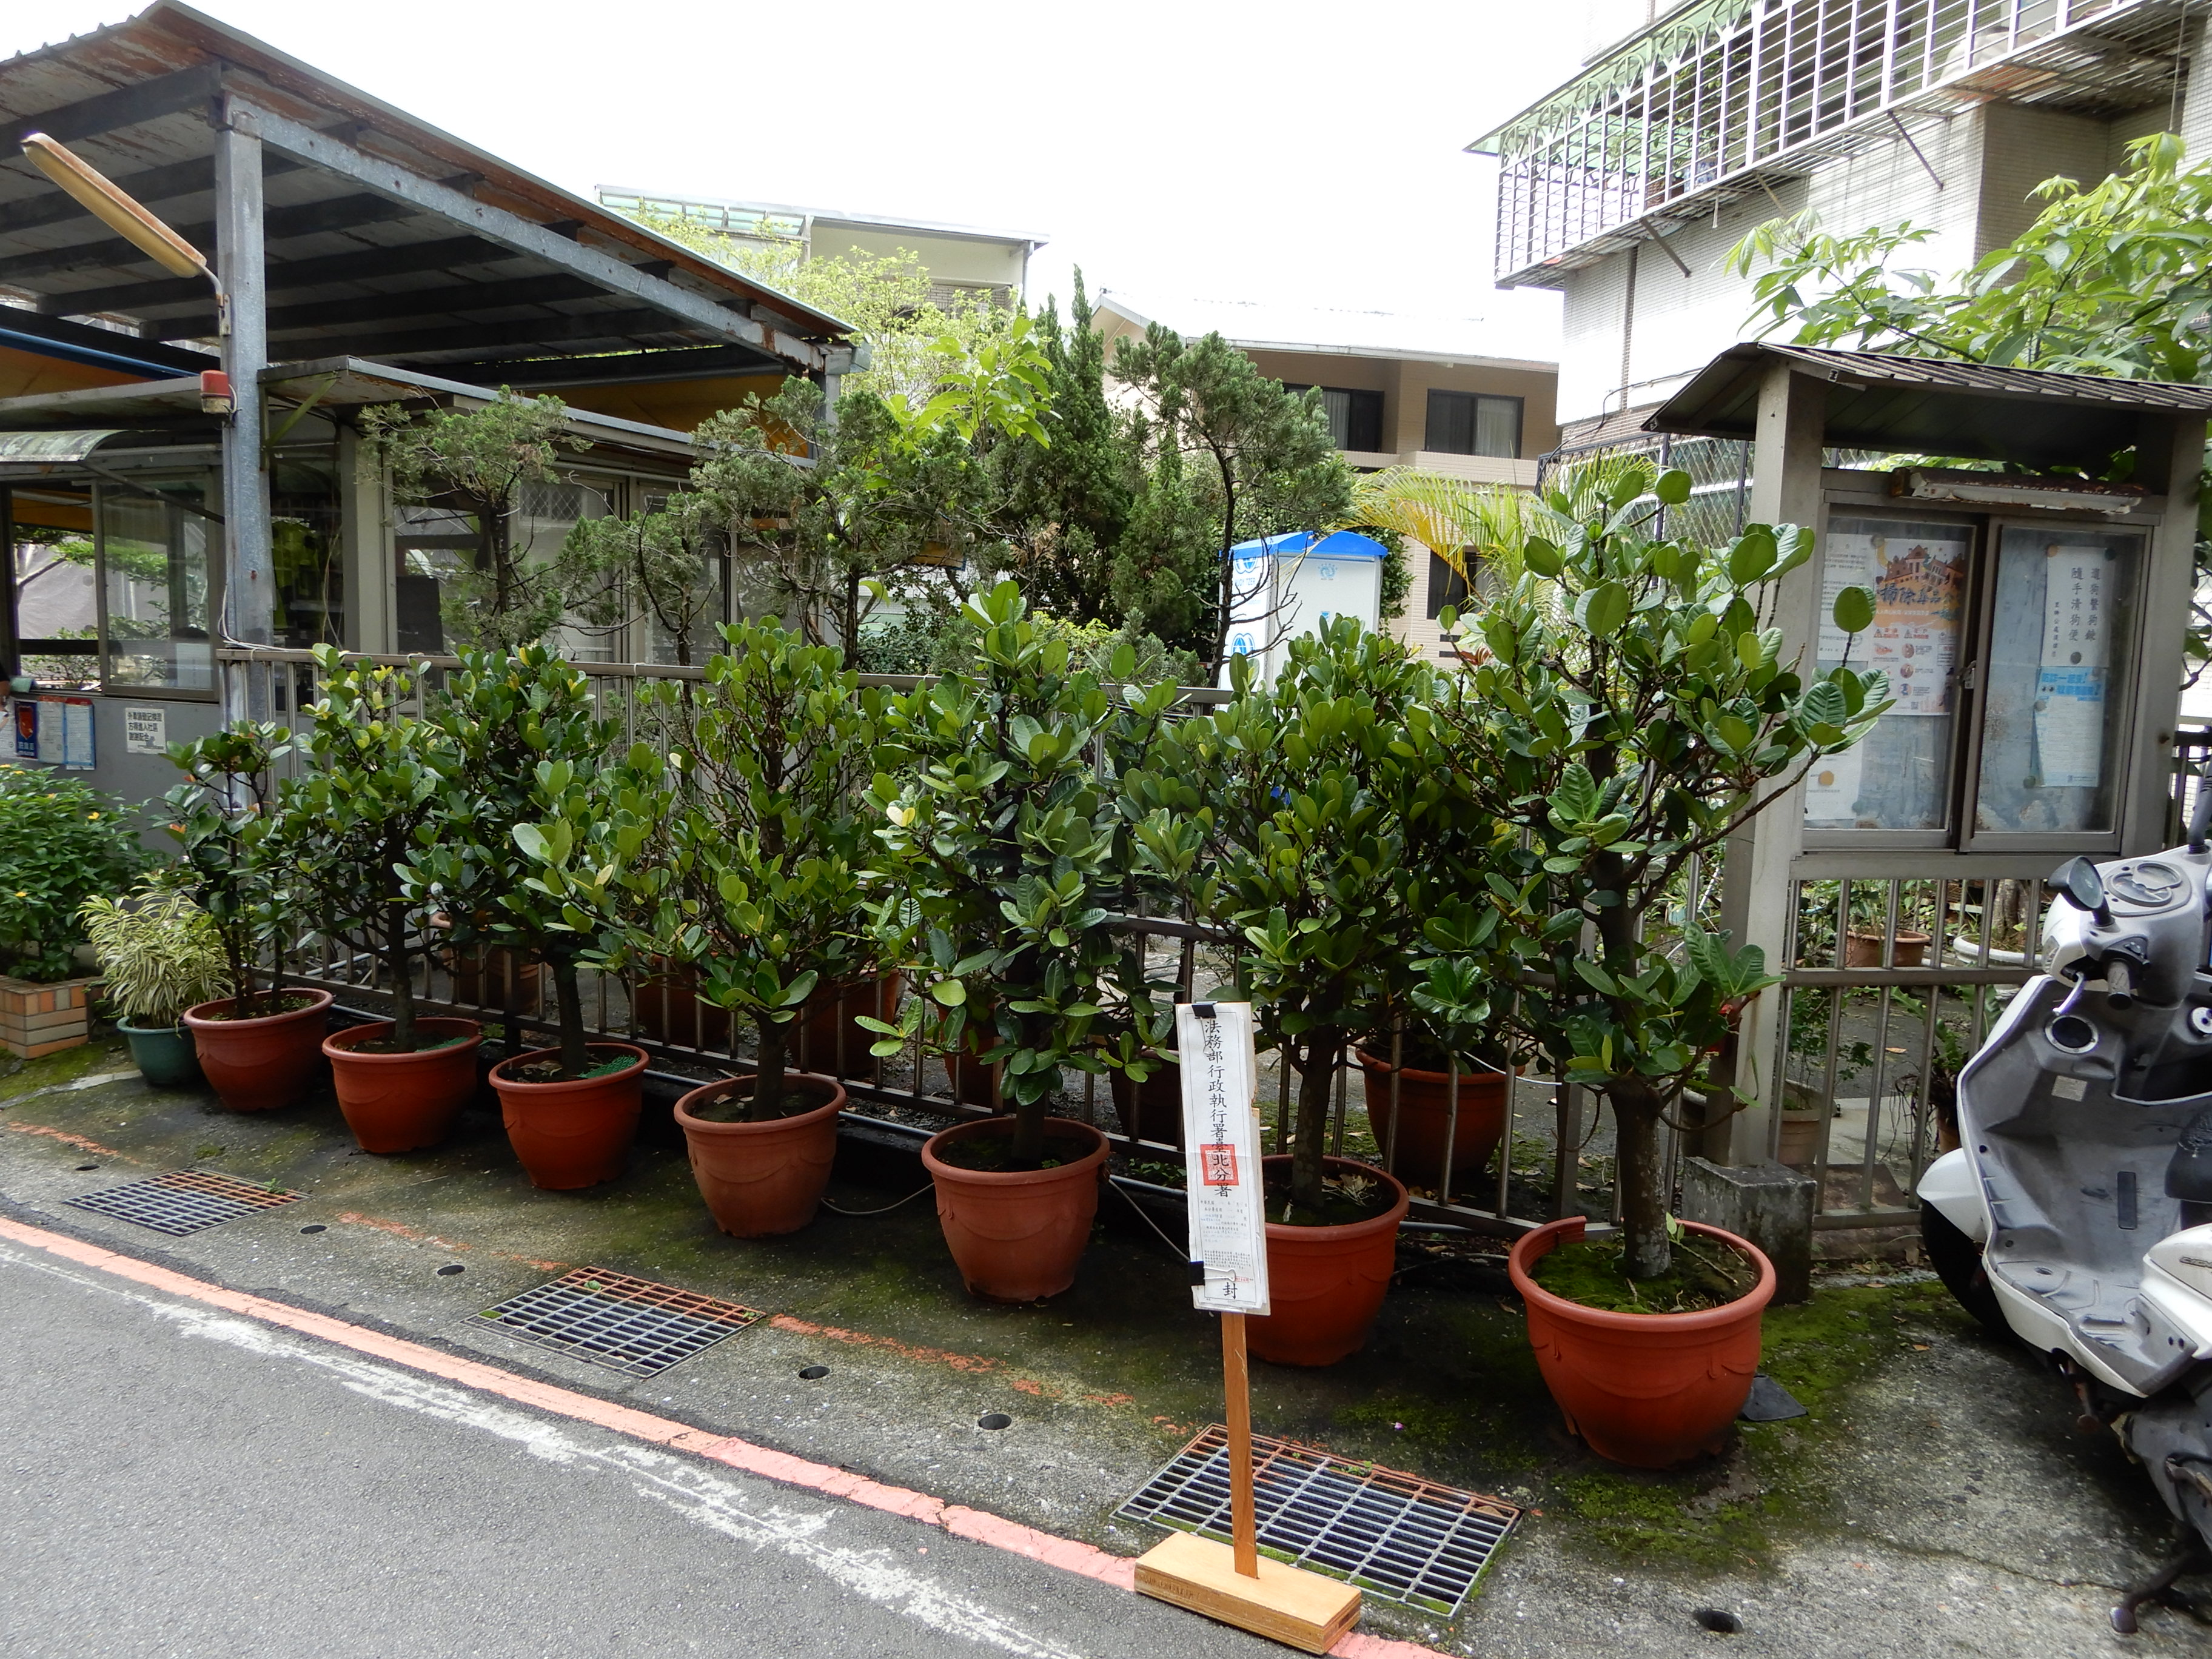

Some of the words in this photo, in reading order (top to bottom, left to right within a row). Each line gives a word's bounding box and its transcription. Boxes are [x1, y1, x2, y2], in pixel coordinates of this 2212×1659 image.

[2068, 568, 2084, 641] 隨手清狗便
[1205, 1020, 1232, 1198] 法務部行政執行署臺北分署
[1222, 1281, 1238, 1299] 封
